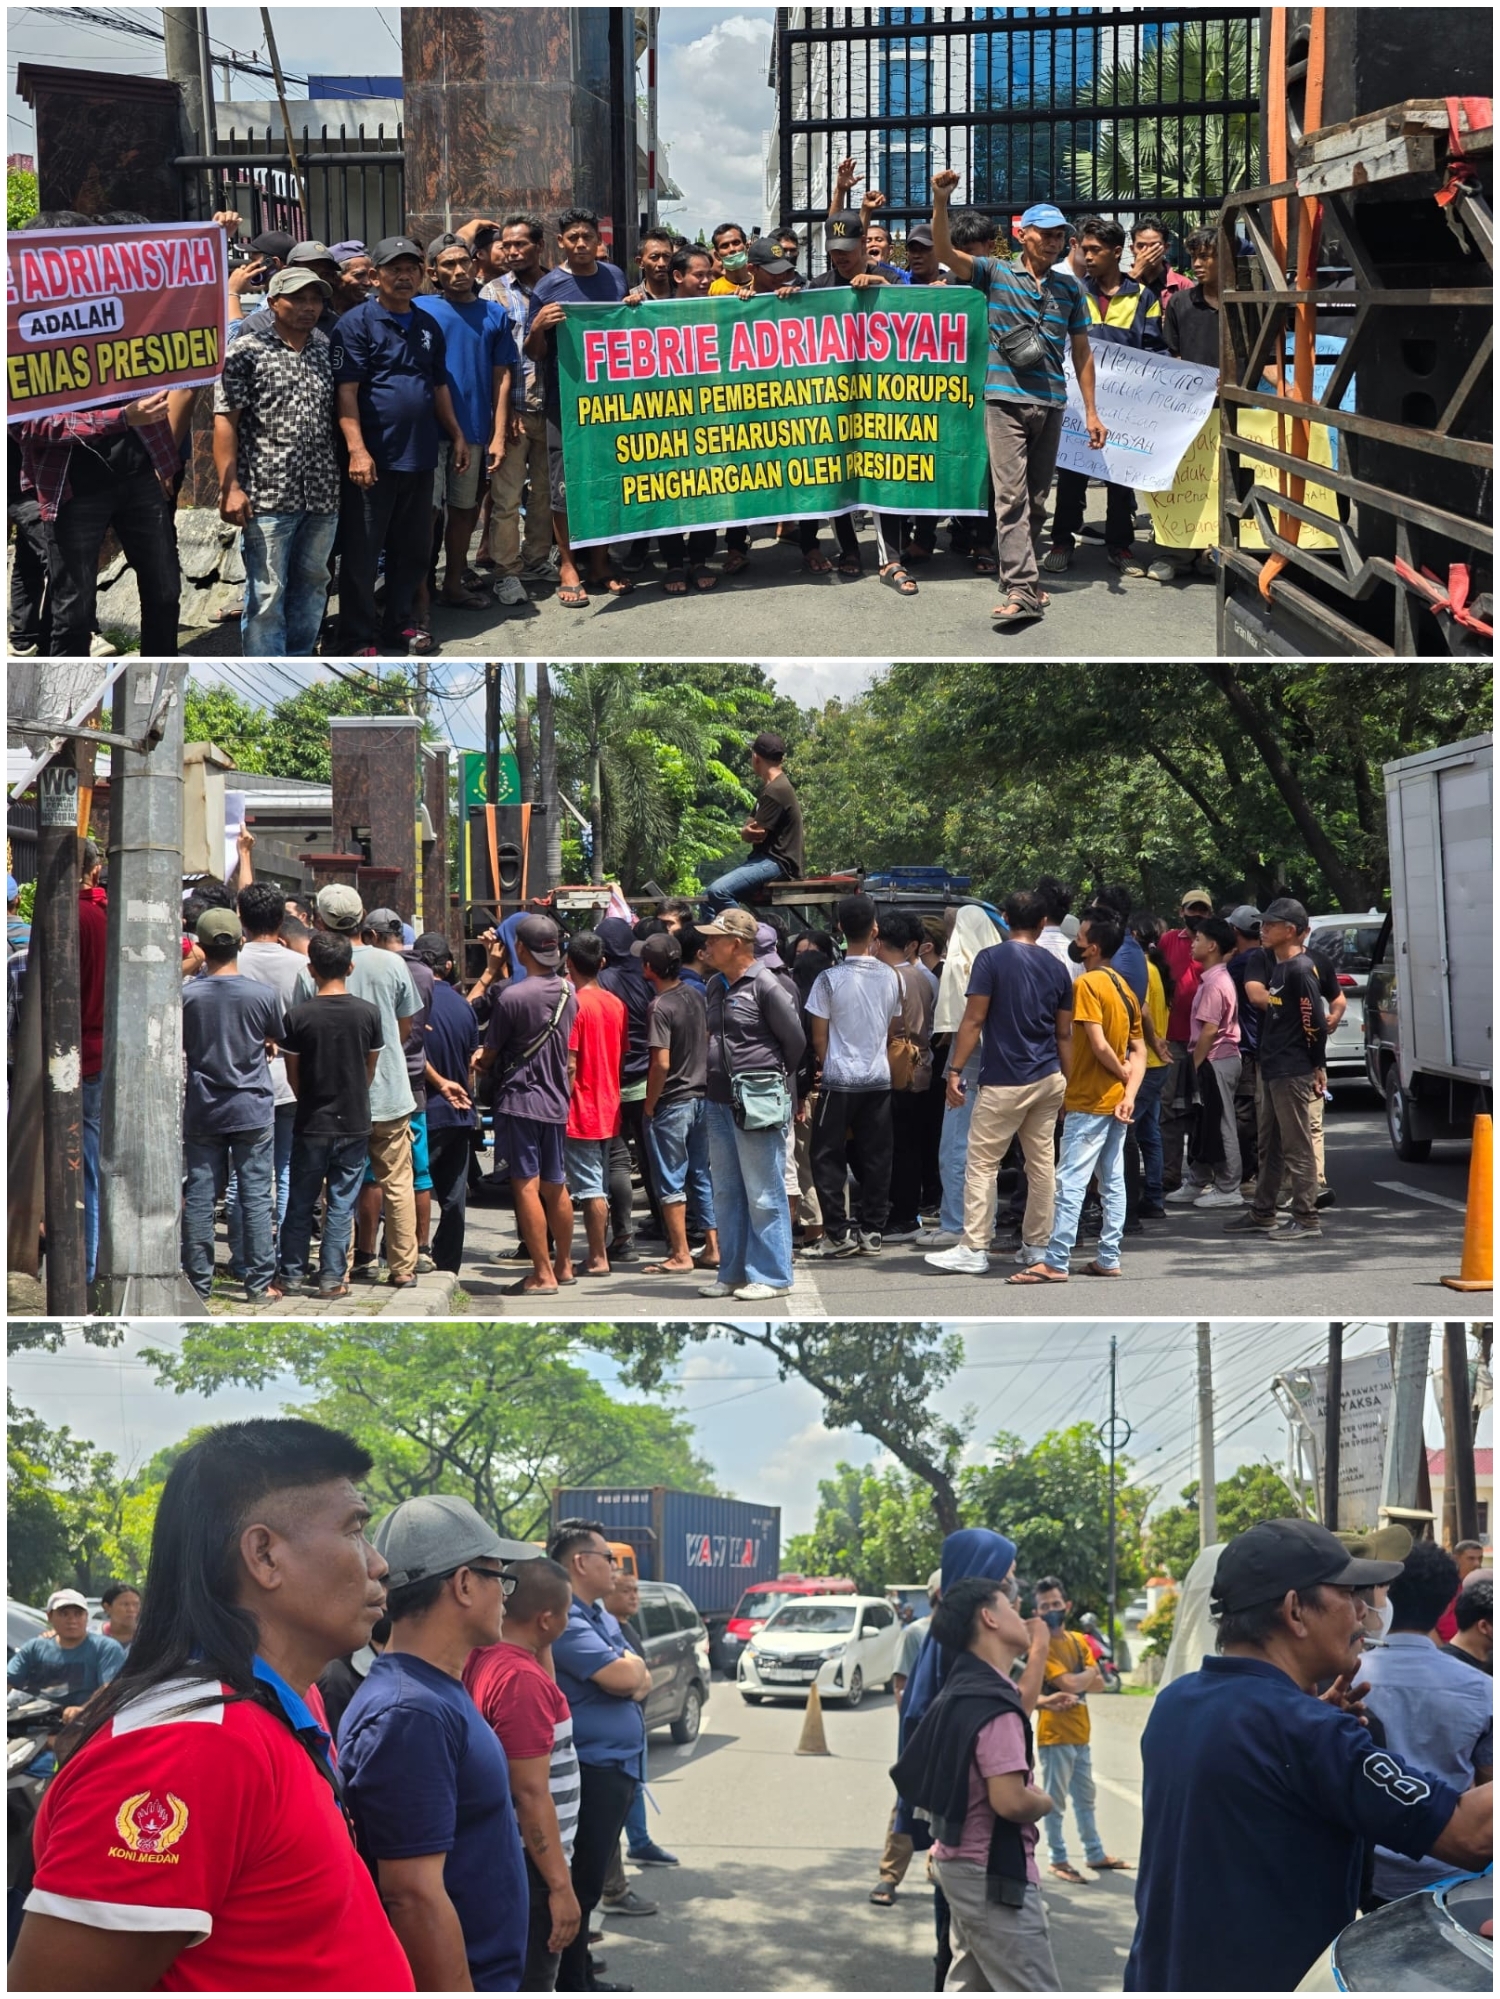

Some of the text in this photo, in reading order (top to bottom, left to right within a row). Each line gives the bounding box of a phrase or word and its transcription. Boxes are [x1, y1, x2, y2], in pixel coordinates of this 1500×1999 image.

[21, 238, 216, 302] ADRIANSYAH
[31, 301, 117, 336] ADALAH
[8, 347, 91, 399] EMAS
[97, 327, 219, 384] PRESIDEN
[583, 311, 968, 383] FEBRIE ADRIANSYAH
[578, 373, 975, 425] PAHLAWAN PEMBERANTASAN KORUPSI,
[615, 411, 938, 464] SUDAH SEHARUSNYA DIBERIKAN
[622, 451, 934, 505] PENGHARGAAN OLEH PRESIDEN
[1151, 489, 1210, 508] Karena
[43, 769, 76, 795] WC
[686, 1533, 760, 1568] WAN HAI
[1363, 1752, 1431, 1805] 8
